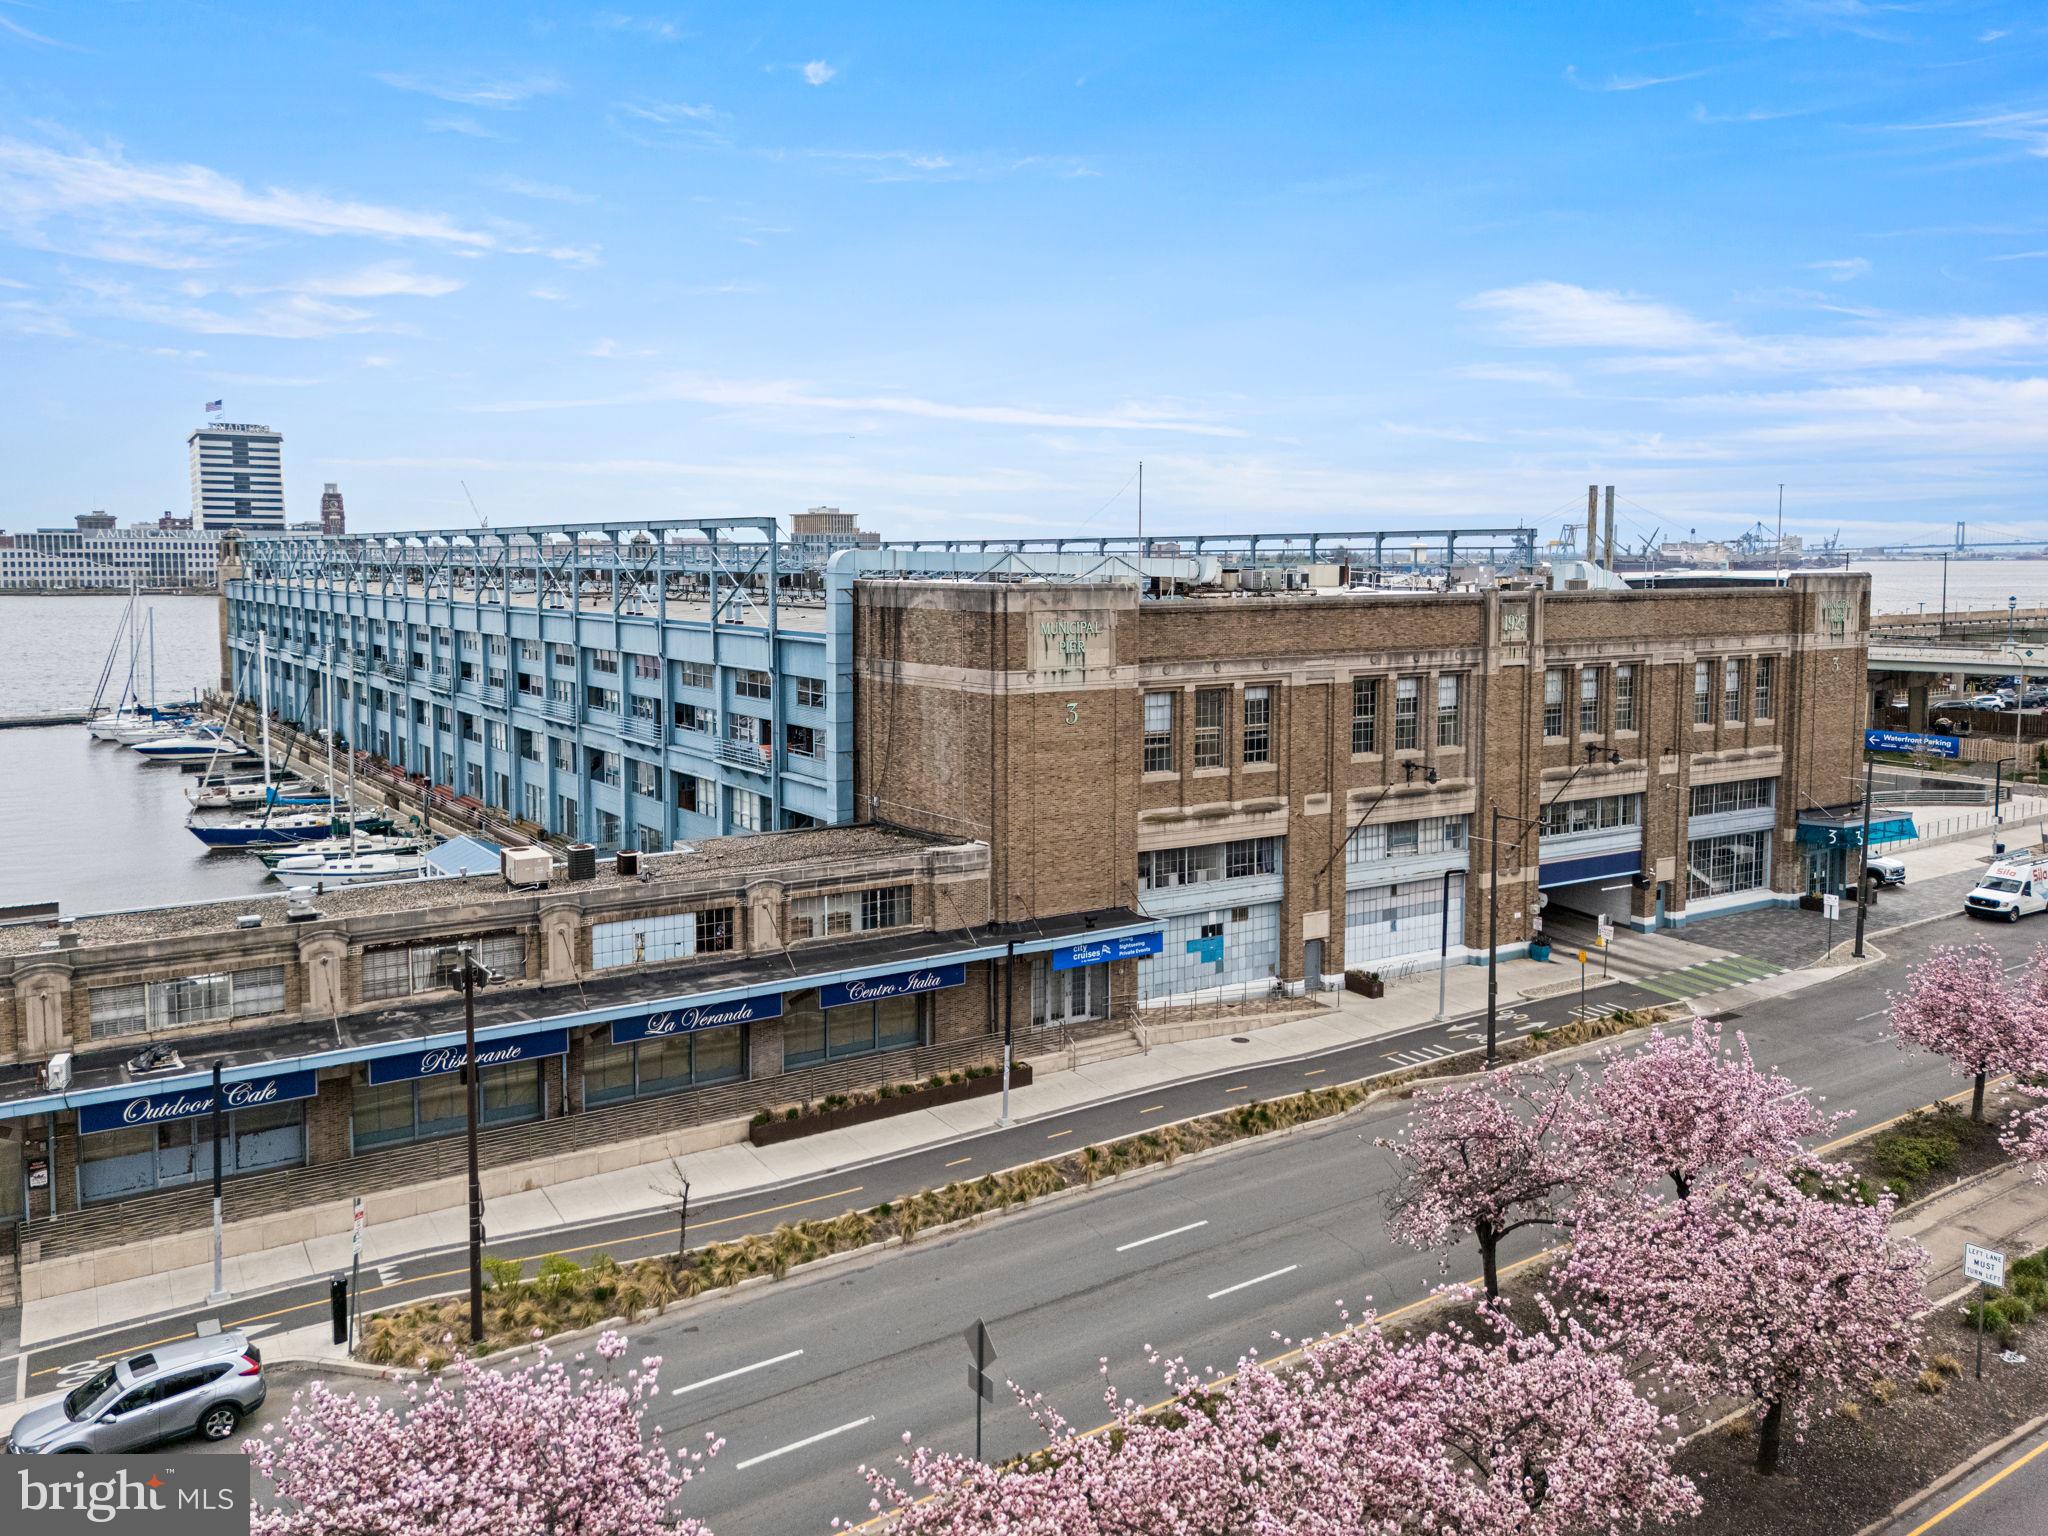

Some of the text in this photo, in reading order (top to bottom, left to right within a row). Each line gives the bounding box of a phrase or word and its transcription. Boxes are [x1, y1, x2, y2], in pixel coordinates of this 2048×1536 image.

[96, 528, 223, 540] AMERICAN WATE
[1040, 621, 1103, 635] MUNICIPAL
[1059, 640, 1086, 654] PIER
[1831, 656, 1840, 672] 3
[1065, 702, 1079, 725] 3
[1883, 733, 1952, 748] Waterfront Parking
[1828, 829, 1838, 845] 3
[1072, 949, 1101, 961] cruises
[1073, 944, 1088, 953] city
[1119, 949, 1135, 957] Private
[845, 971, 942, 1001] Centro Italia
[644, 1003, 754, 1035] La Veranda
[420, 1045, 521, 1073] Ristrante
[123, 1079, 278, 1124] Outdoor Cafe
[1968, 1248, 2001, 1263] LEFT LANE
[1974, 1259, 1995, 1270] MUST
[1967, 1267, 2001, 1282] TURN LEFT
